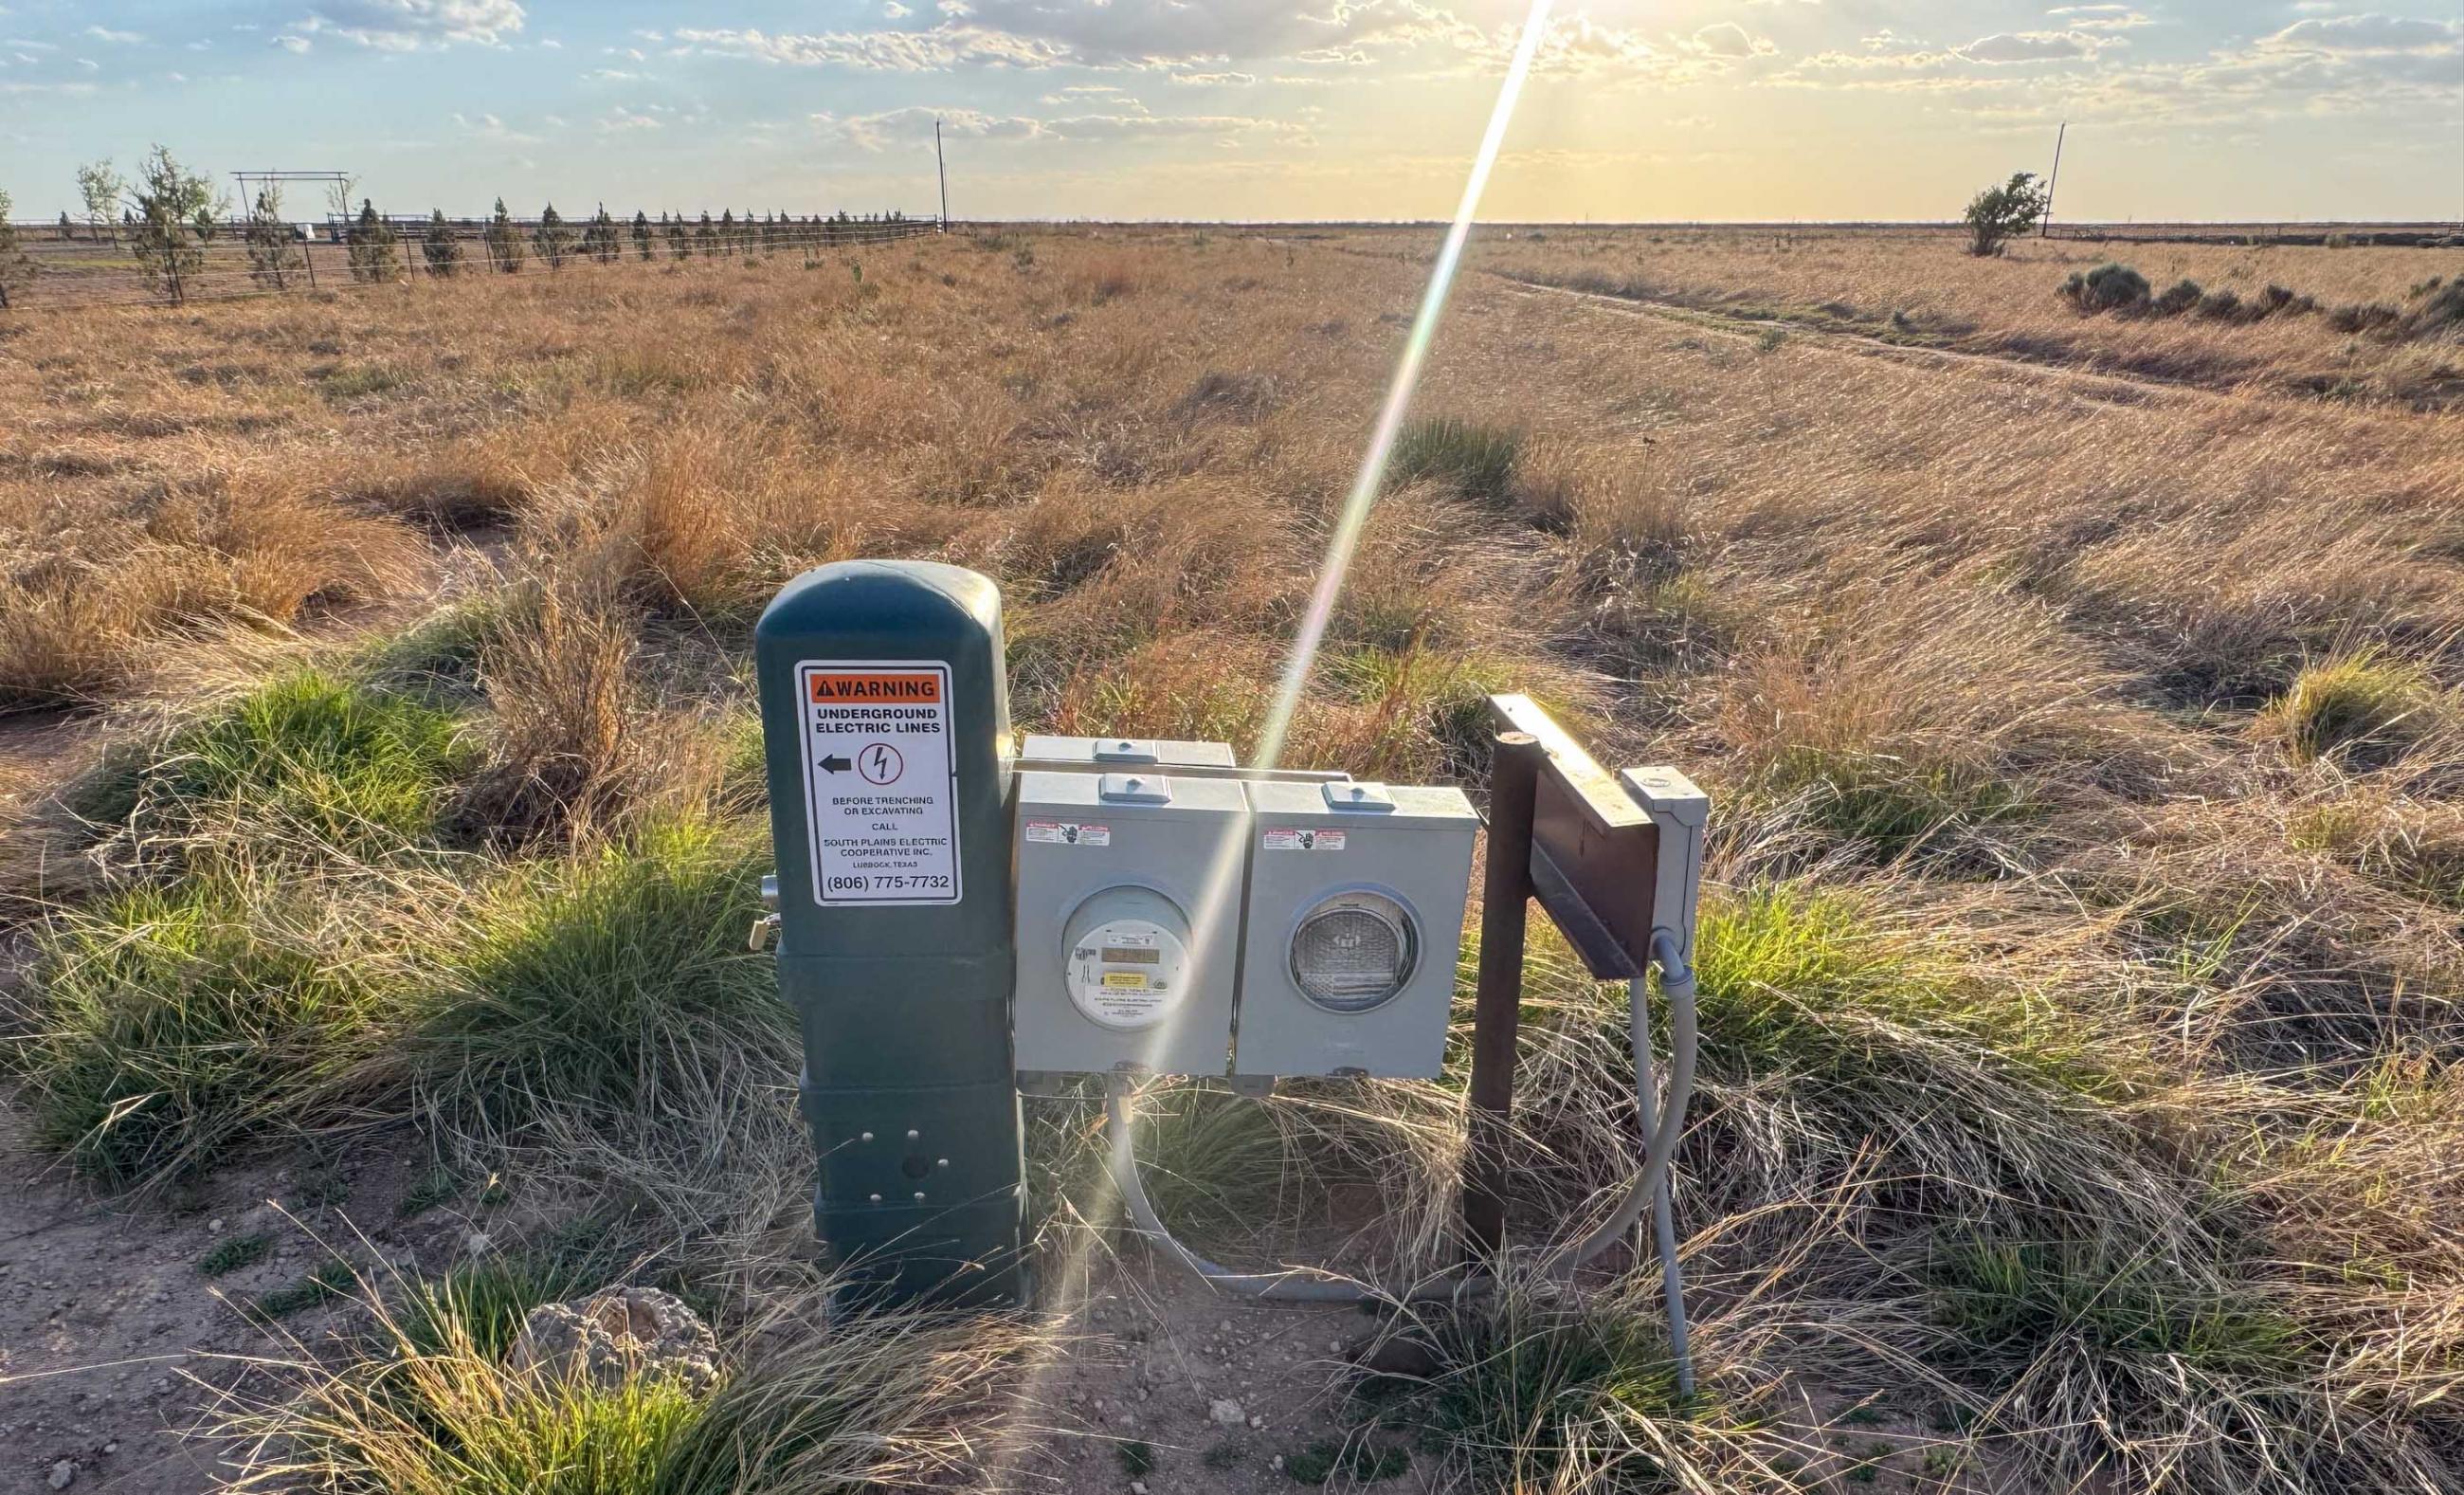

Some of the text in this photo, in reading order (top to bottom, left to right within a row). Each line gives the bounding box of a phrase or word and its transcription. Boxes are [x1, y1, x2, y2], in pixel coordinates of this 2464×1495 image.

[836, 681, 935, 697] WARNING
[817, 708, 937, 720] UNDERGROUND
[816, 722, 941, 734] ELECTRIC LINES
[832, 796, 933, 806] BEFORE TRENCHING
[861, 807, 923, 815] EXCAVATING
[861, 838, 897, 847] PLAINS
[899, 838, 948, 847] ELECTRIC
[841, 848, 910, 857] COOPERATIVE
[827, 875, 950, 893] (806) 775-7732
